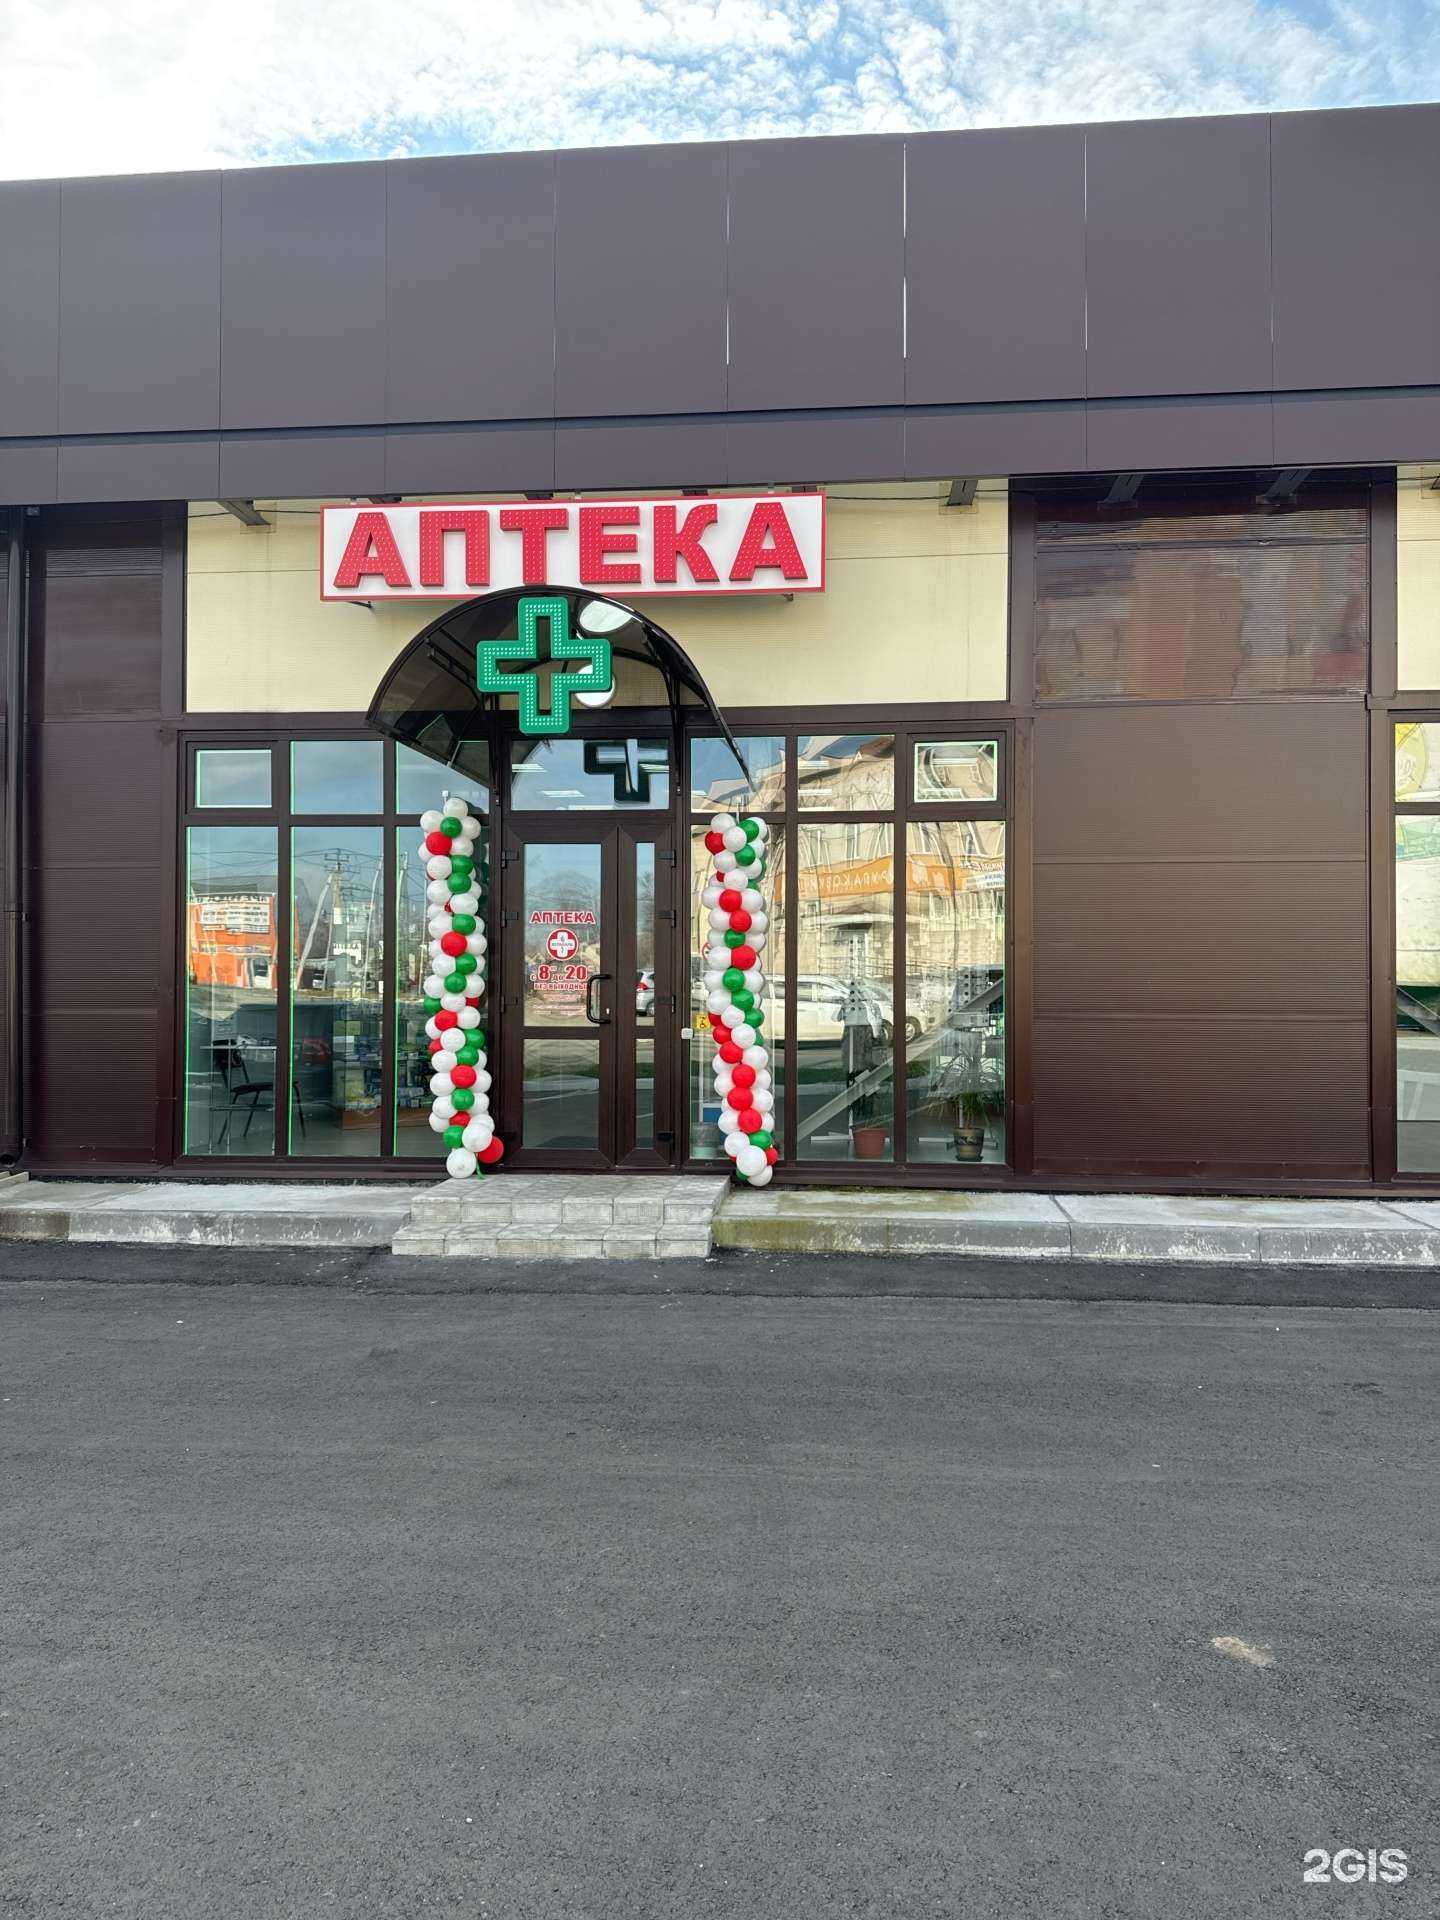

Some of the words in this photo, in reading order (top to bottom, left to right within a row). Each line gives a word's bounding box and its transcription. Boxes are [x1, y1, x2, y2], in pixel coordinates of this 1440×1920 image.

[333, 502, 808, 588] АПТЕКА
[530, 911, 596, 925] АПТЕКА
[548, 982, 588, 992] ВЫХОДНЫ
